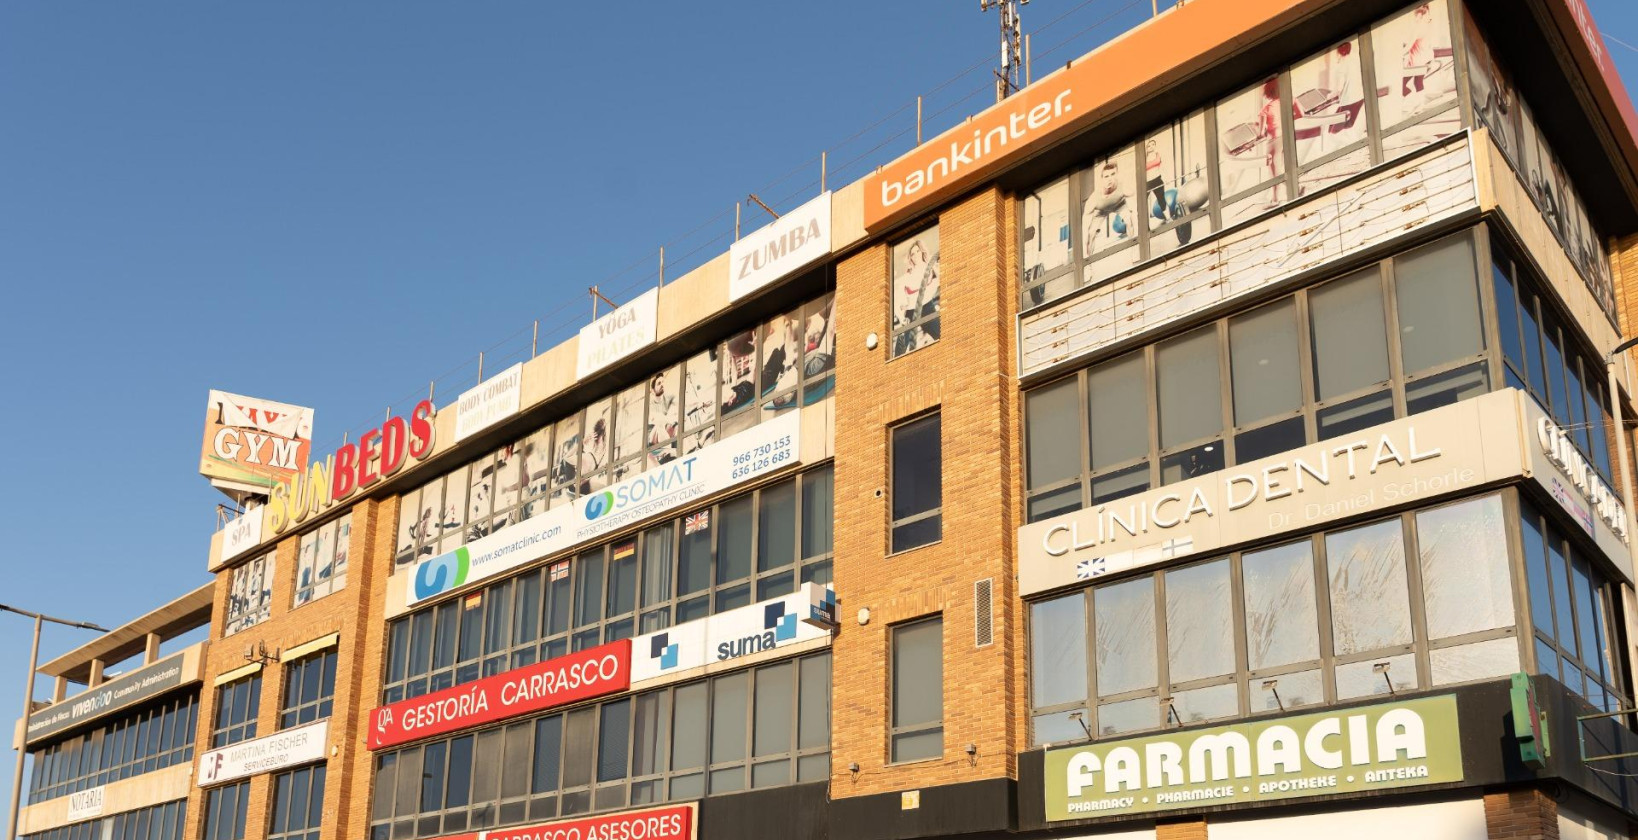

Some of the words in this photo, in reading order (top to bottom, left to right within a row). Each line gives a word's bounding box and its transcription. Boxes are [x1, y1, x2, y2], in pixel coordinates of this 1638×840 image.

[880, 88, 1073, 208] bankinter.
[737, 217, 821, 281] ZUMBA
[598, 306, 637, 340] YOGA
[585, 330, 645, 370] PILATES
[459, 392, 482, 416] BODY
[483, 372, 519, 403] COMBAT
[213, 426, 303, 472] GYM
[732, 464, 750, 480] 636
[752, 457, 769, 472] 126
[771, 448, 791, 464] 683
[733, 450, 751, 467] 966
[753, 443, 771, 459] 730
[773, 435, 791, 451] 153
[615, 457, 697, 509] SOMAT
[1042, 486, 1214, 557] CLÍNICA
[1225, 427, 1442, 512] DENTAL
[1305, 489, 1375, 523] Daniel
[1383, 466, 1476, 503] Schorle
[576, 511, 631, 540] PHYSIOTHERAPY
[631, 493, 678, 520] OSTEOPATHY
[678, 483, 706, 503] CLINIC
[231, 522, 251, 547] SPA
[471, 525, 563, 567] www.somatclinic.com
[717, 630, 777, 661] suma
[402, 685, 489, 732] GESTORÍA
[500, 654, 620, 707] CARRASCO
[230, 744, 266, 763] MARTINA
[268, 732, 308, 753] FISCHER
[1067, 707, 1428, 799] FARMACIA
[1067, 796, 1134, 813] PHARMACY
[1156, 785, 1234, 804] PHARMACIE
[1259, 775, 1337, 794] APOTHEKE
[587, 813, 681, 840] ASESORES
